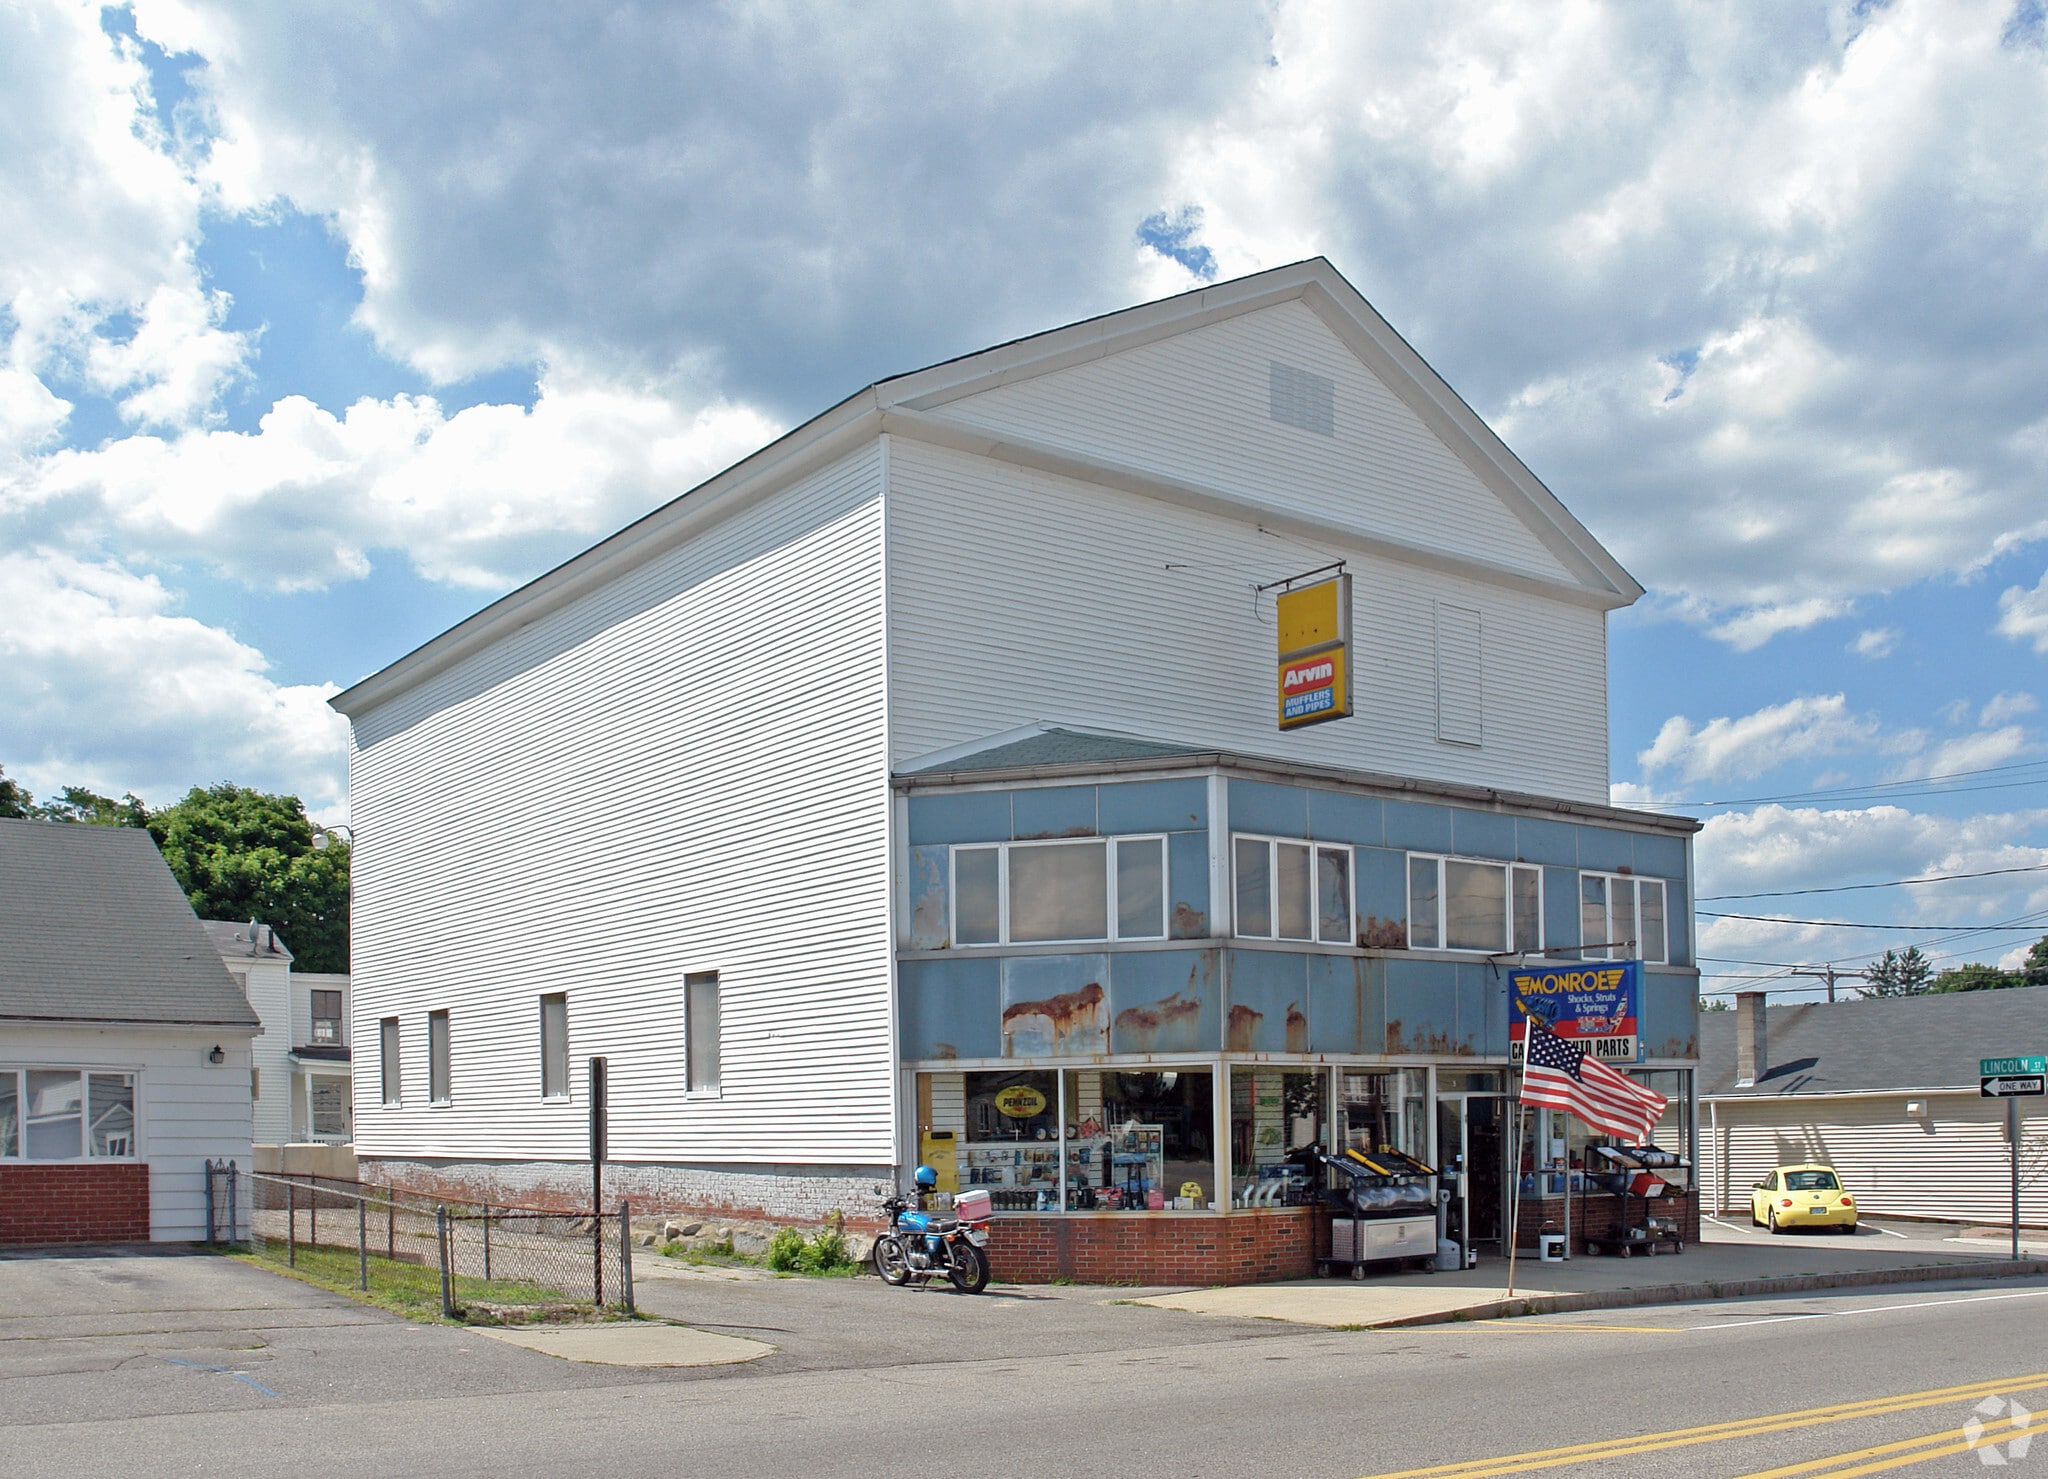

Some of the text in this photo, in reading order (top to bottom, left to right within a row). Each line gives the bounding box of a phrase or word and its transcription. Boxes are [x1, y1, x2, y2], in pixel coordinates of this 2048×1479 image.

[1284, 662, 1332, 688] Arvin
[1285, 689, 1330, 708] MUFFLERS
[1286, 698, 1330, 718] AND PIPES
[1528, 971, 1609, 995] MONROE
[1567, 992, 1616, 1004] Shocks, Struts
[1575, 1003, 1608, 1015] & Springs
[1566, 1038, 1629, 1057] UTO PARTS
[1984, 1059, 2028, 1074] LINCOLN
[1999, 1080, 2038, 1091] ONE WAY
[1003, 1096, 1038, 1108] PENNZOIL
